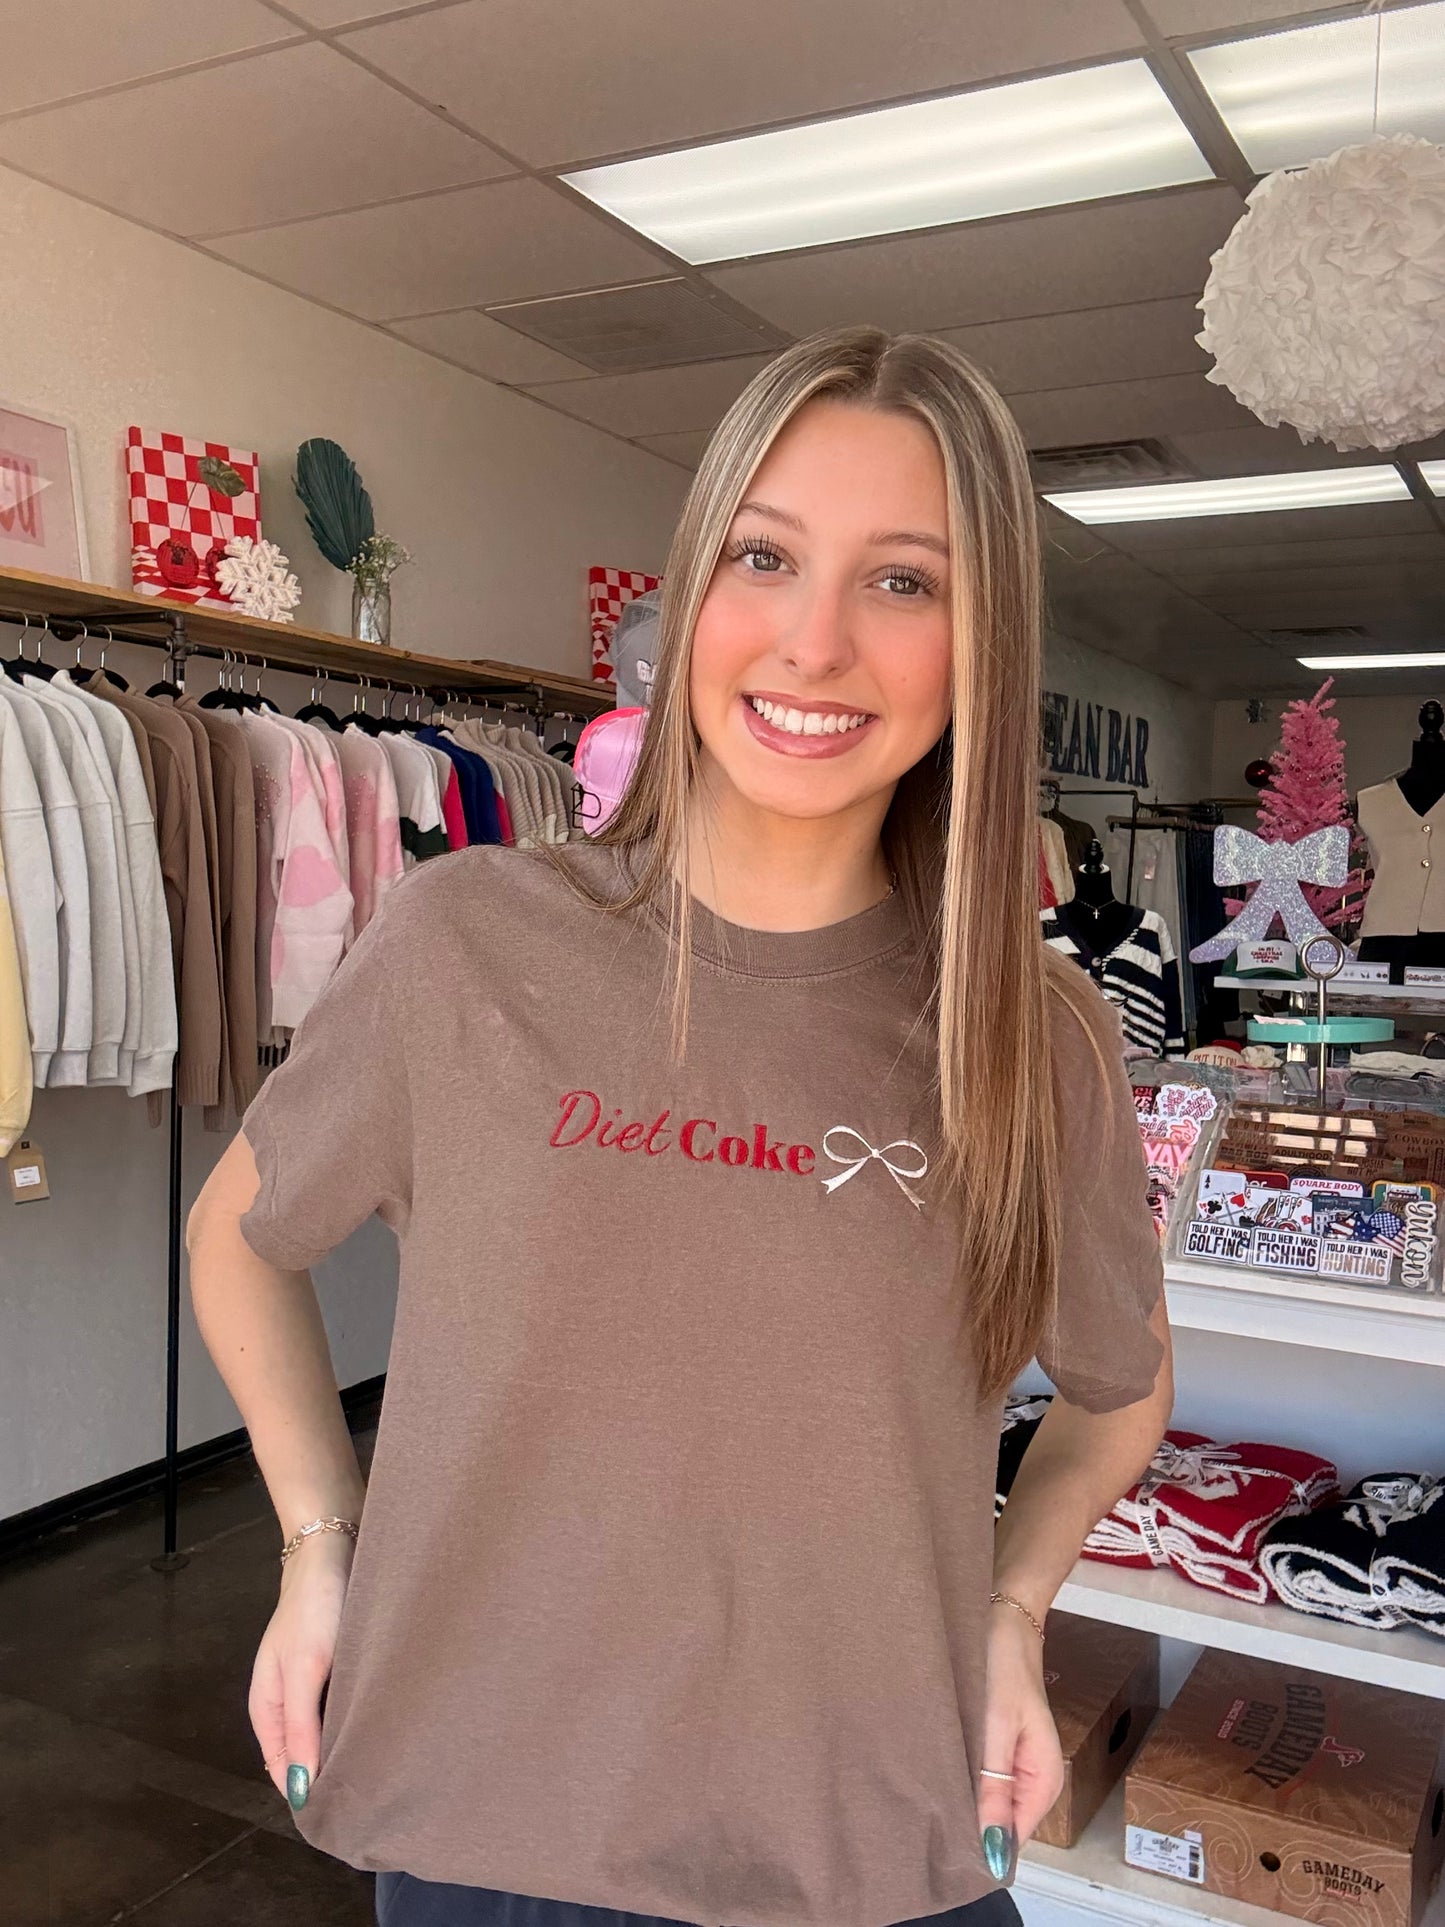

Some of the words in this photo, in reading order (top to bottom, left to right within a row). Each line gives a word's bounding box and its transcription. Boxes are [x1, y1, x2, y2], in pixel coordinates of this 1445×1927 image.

[1043, 689, 1104, 779] EAN
[1105, 708, 1150, 788] BAR
[549, 1089, 672, 1156] Diet
[679, 1119, 816, 1175] Coke
[1292, 1179, 1333, 1189] SQUARE
[1333, 1180, 1361, 1191] BODY
[1191, 1223, 1209, 1234] TOLD
[1210, 1225, 1225, 1237] HER
[1231, 1229, 1248, 1239] WAS
[1257, 1231, 1277, 1243] TOLD
[1278, 1234, 1293, 1245] HER
[1300, 1237, 1318, 1248] WAS
[1188, 1233, 1244, 1258] GOLFING
[1256, 1242, 1317, 1267] FISHING
[1326, 1243, 1346, 1253] TOLD
[1347, 1245, 1363, 1255] HER
[1370, 1249, 1388, 1259] WAS
[1323, 1252, 1386, 1278] HUNTING
[1141, 1515, 1155, 1533] DAY
[1146, 1534, 1164, 1556] GAME
[1231, 1700, 1279, 1750] BOOTS
[1243, 1683, 1326, 1790] GAMEDAY
[1302, 1860, 1385, 1893] GAMEDAY
[1324, 1876, 1362, 1896] BOOTS
